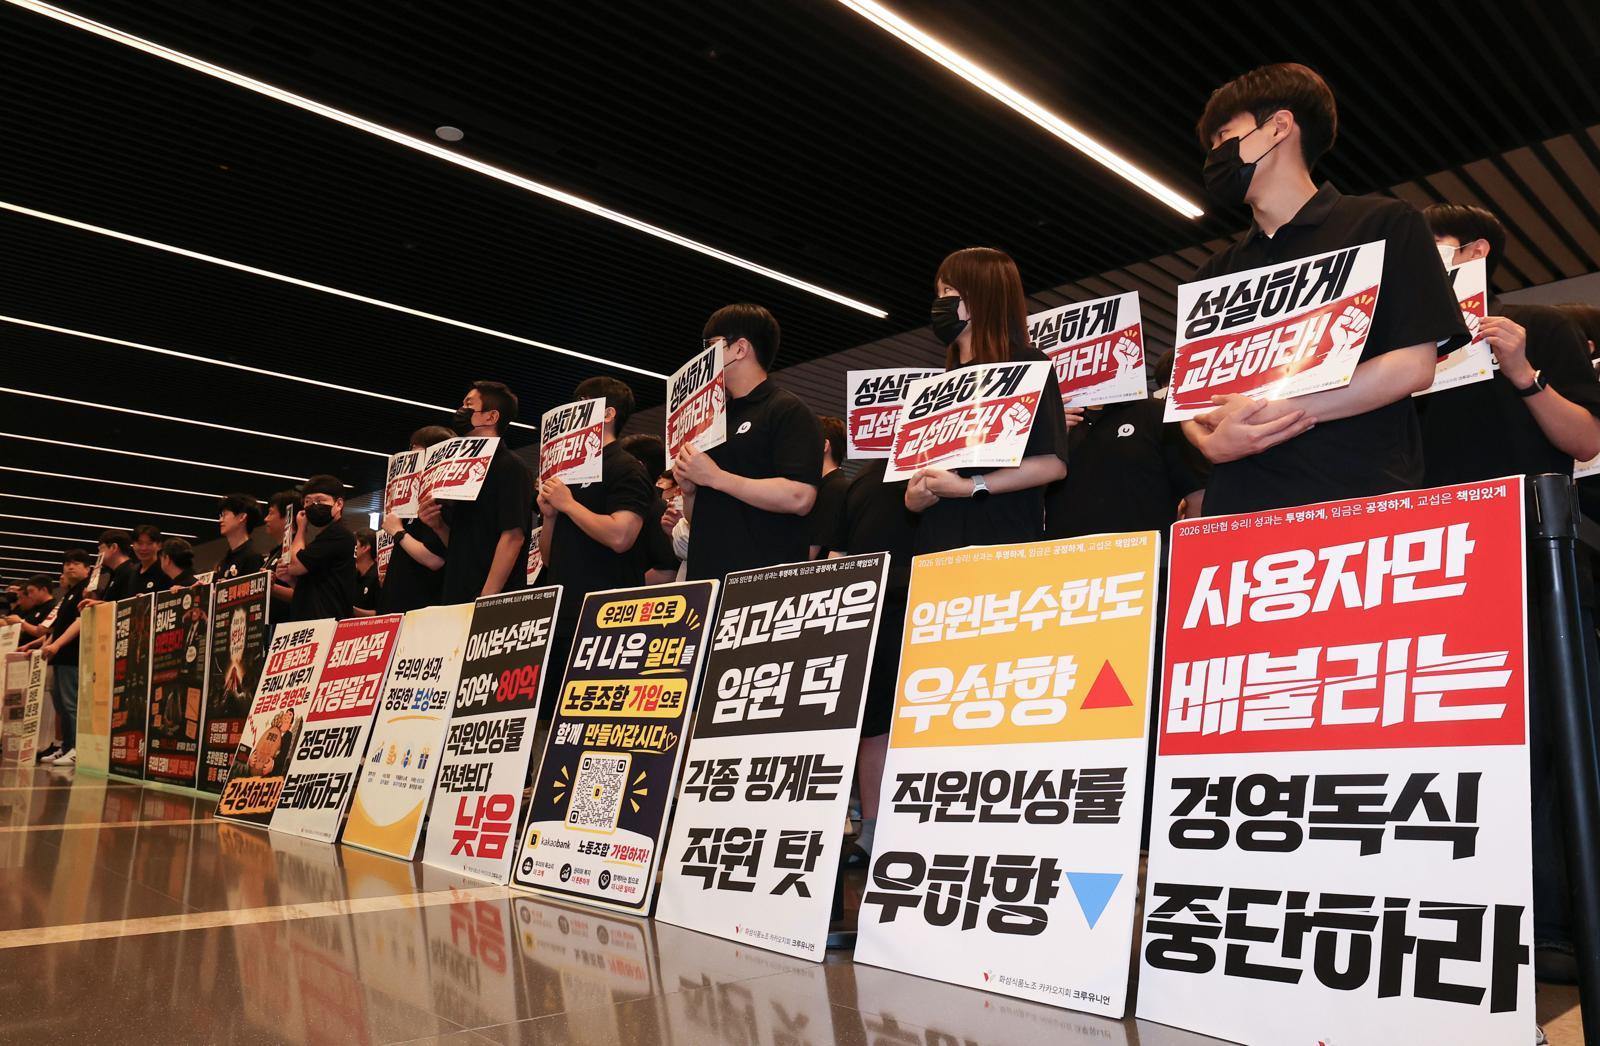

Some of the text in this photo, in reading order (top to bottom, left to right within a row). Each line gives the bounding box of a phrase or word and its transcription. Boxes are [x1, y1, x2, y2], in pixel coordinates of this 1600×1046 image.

[1185, 247, 1361, 340] 성실하게
[1176, 312, 1332, 394] 교섭하라!
[670, 347, 716, 413] 성실하게
[908, 364, 1032, 420] 성실하게
[543, 401, 596, 444] 성실하게
[854, 409, 902, 441] 교섭
[897, 404, 1004, 460] 교섭하라!
[424, 439, 489, 471] 성실하게
[1179, 485, 1506, 537] 2026 임단협 승리! 성과는 투명하게, 임금은 공정하게, 교섭은 책임있게
[995, 548, 1026, 560] 투명하게,
[1053, 543, 1086, 555] 공정하게,
[1088, 540, 1112, 552] 교섭은
[1114, 536, 1148, 548] 책임있게
[1182, 522, 1476, 629] 사용자만
[603, 601, 678, 624] 우리의 힘으로
[714, 579, 878, 652] 최고실적은
[909, 571, 1146, 645] 임원보수한도
[289, 627, 315, 647] 폭락은
[327, 631, 390, 668] 최대실적
[465, 616, 552, 662] 이사보수한도
[573, 632, 696, 671] 더 나은 일터를
[261, 666, 315, 694] 주머니 채우기
[395, 656, 444, 683] 우리의 성과,
[456, 664, 540, 709] 50억 80억
[711, 653, 848, 725] 임원 덕
[1165, 634, 1513, 736] 배불리는
[254, 687, 311, 714] 급급한 경영진은
[310, 672, 383, 713] 자랑말고
[385, 688, 451, 711] 정당한 보상으로!
[565, 684, 682, 711] 노동조합 가입으로
[899, 655, 1080, 734] 우상향
[297, 725, 362, 761] 정당하게
[447, 717, 527, 757] 직원인상률
[555, 722, 668, 749] 함께 만들어갑시다
[277, 772, 353, 810] 분배하라
[440, 762, 493, 793] 작년보다
[683, 754, 843, 802] 각종 핑계는
[891, 766, 1128, 825] 직원인상률
[450, 794, 515, 859] 낮음
[1169, 772, 1482, 860] 경영독식
[540, 837, 571, 850] kakaobank
[577, 840, 650, 863] 노동조합 가입하자!
[680, 827, 824, 899] 직원 탓
[863, 851, 1061, 936] 우하향
[792, 939, 815, 952] 크루유니언
[1144, 882, 1532, 1014] 중단하라
[999, 975, 1110, 1005] 화섬식품노조 카카오지회 크루유니언
